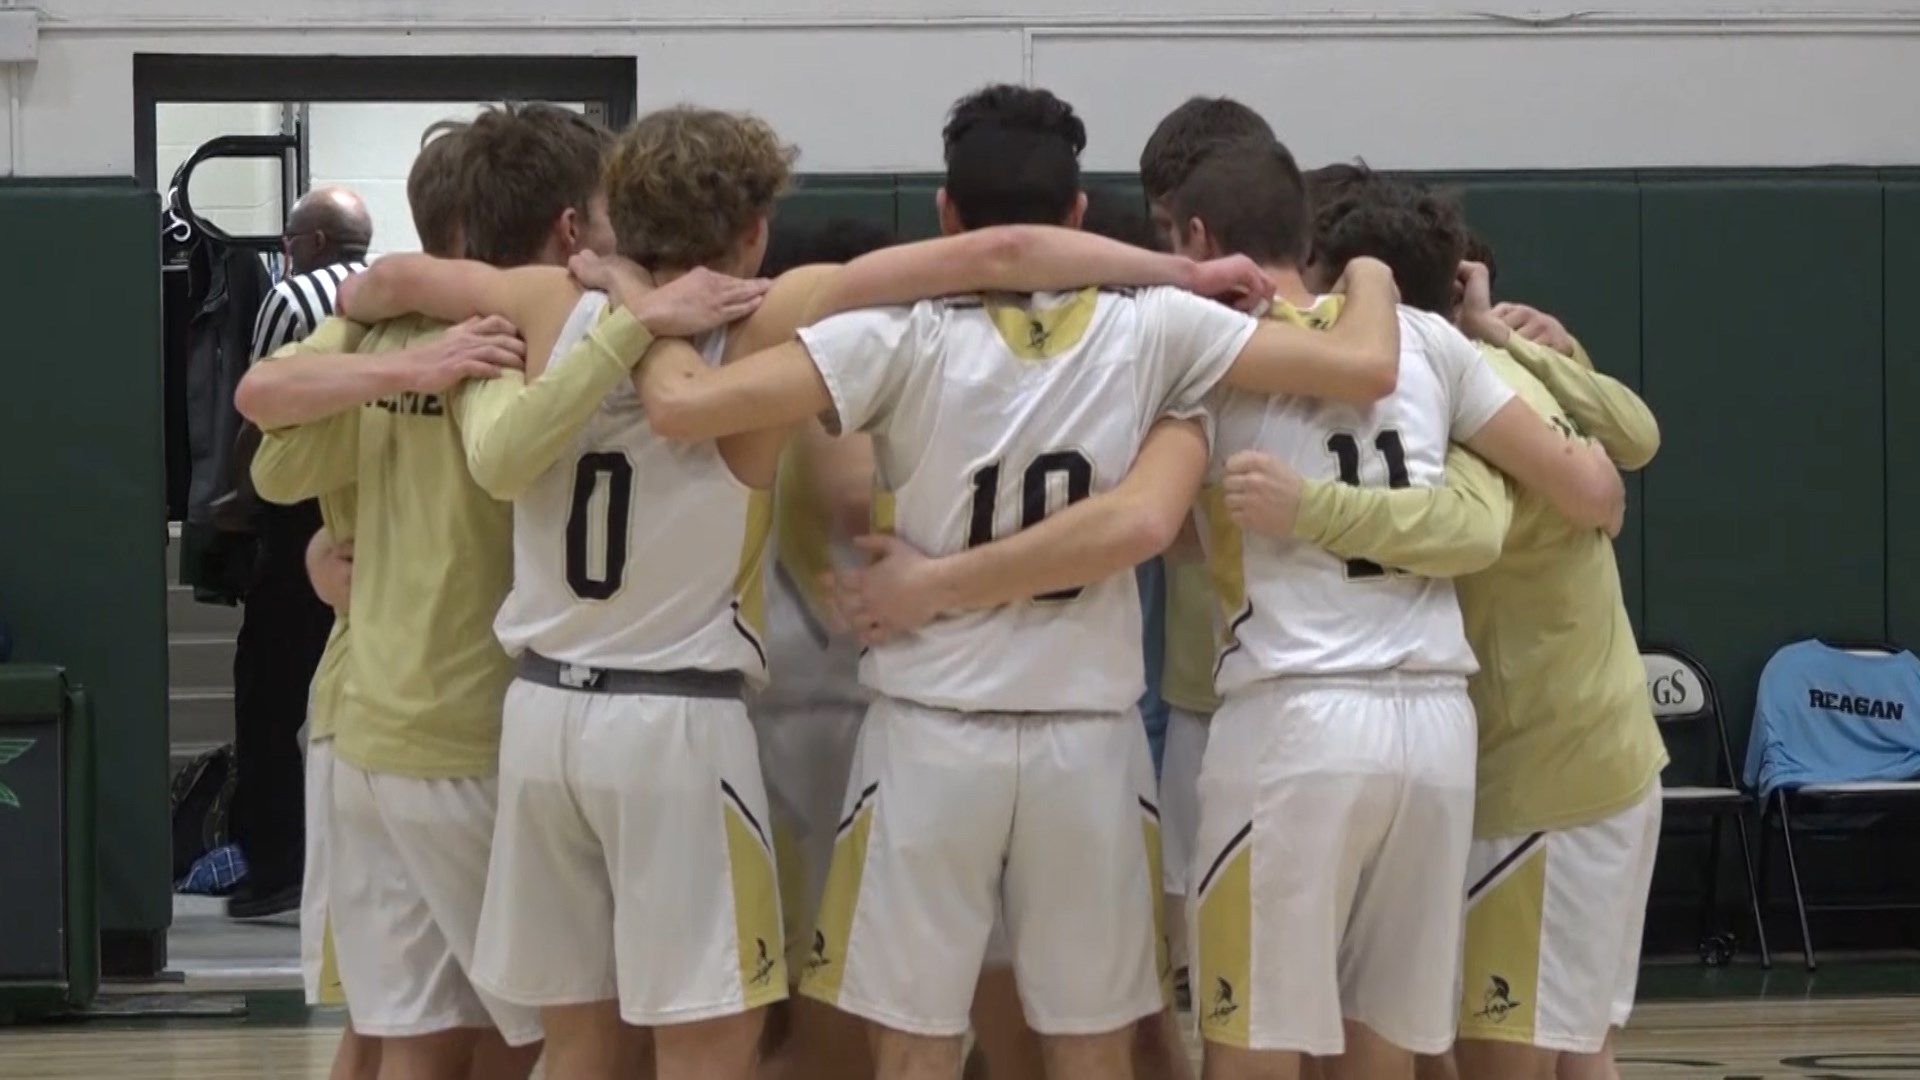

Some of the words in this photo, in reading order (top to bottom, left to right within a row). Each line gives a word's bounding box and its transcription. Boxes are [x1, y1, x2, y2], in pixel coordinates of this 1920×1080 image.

[565, 452, 633, 600] 0
[967, 450, 1093, 602] 10
[1647, 669, 1686, 706] GS
[1808, 688, 1904, 721] REAGAN
